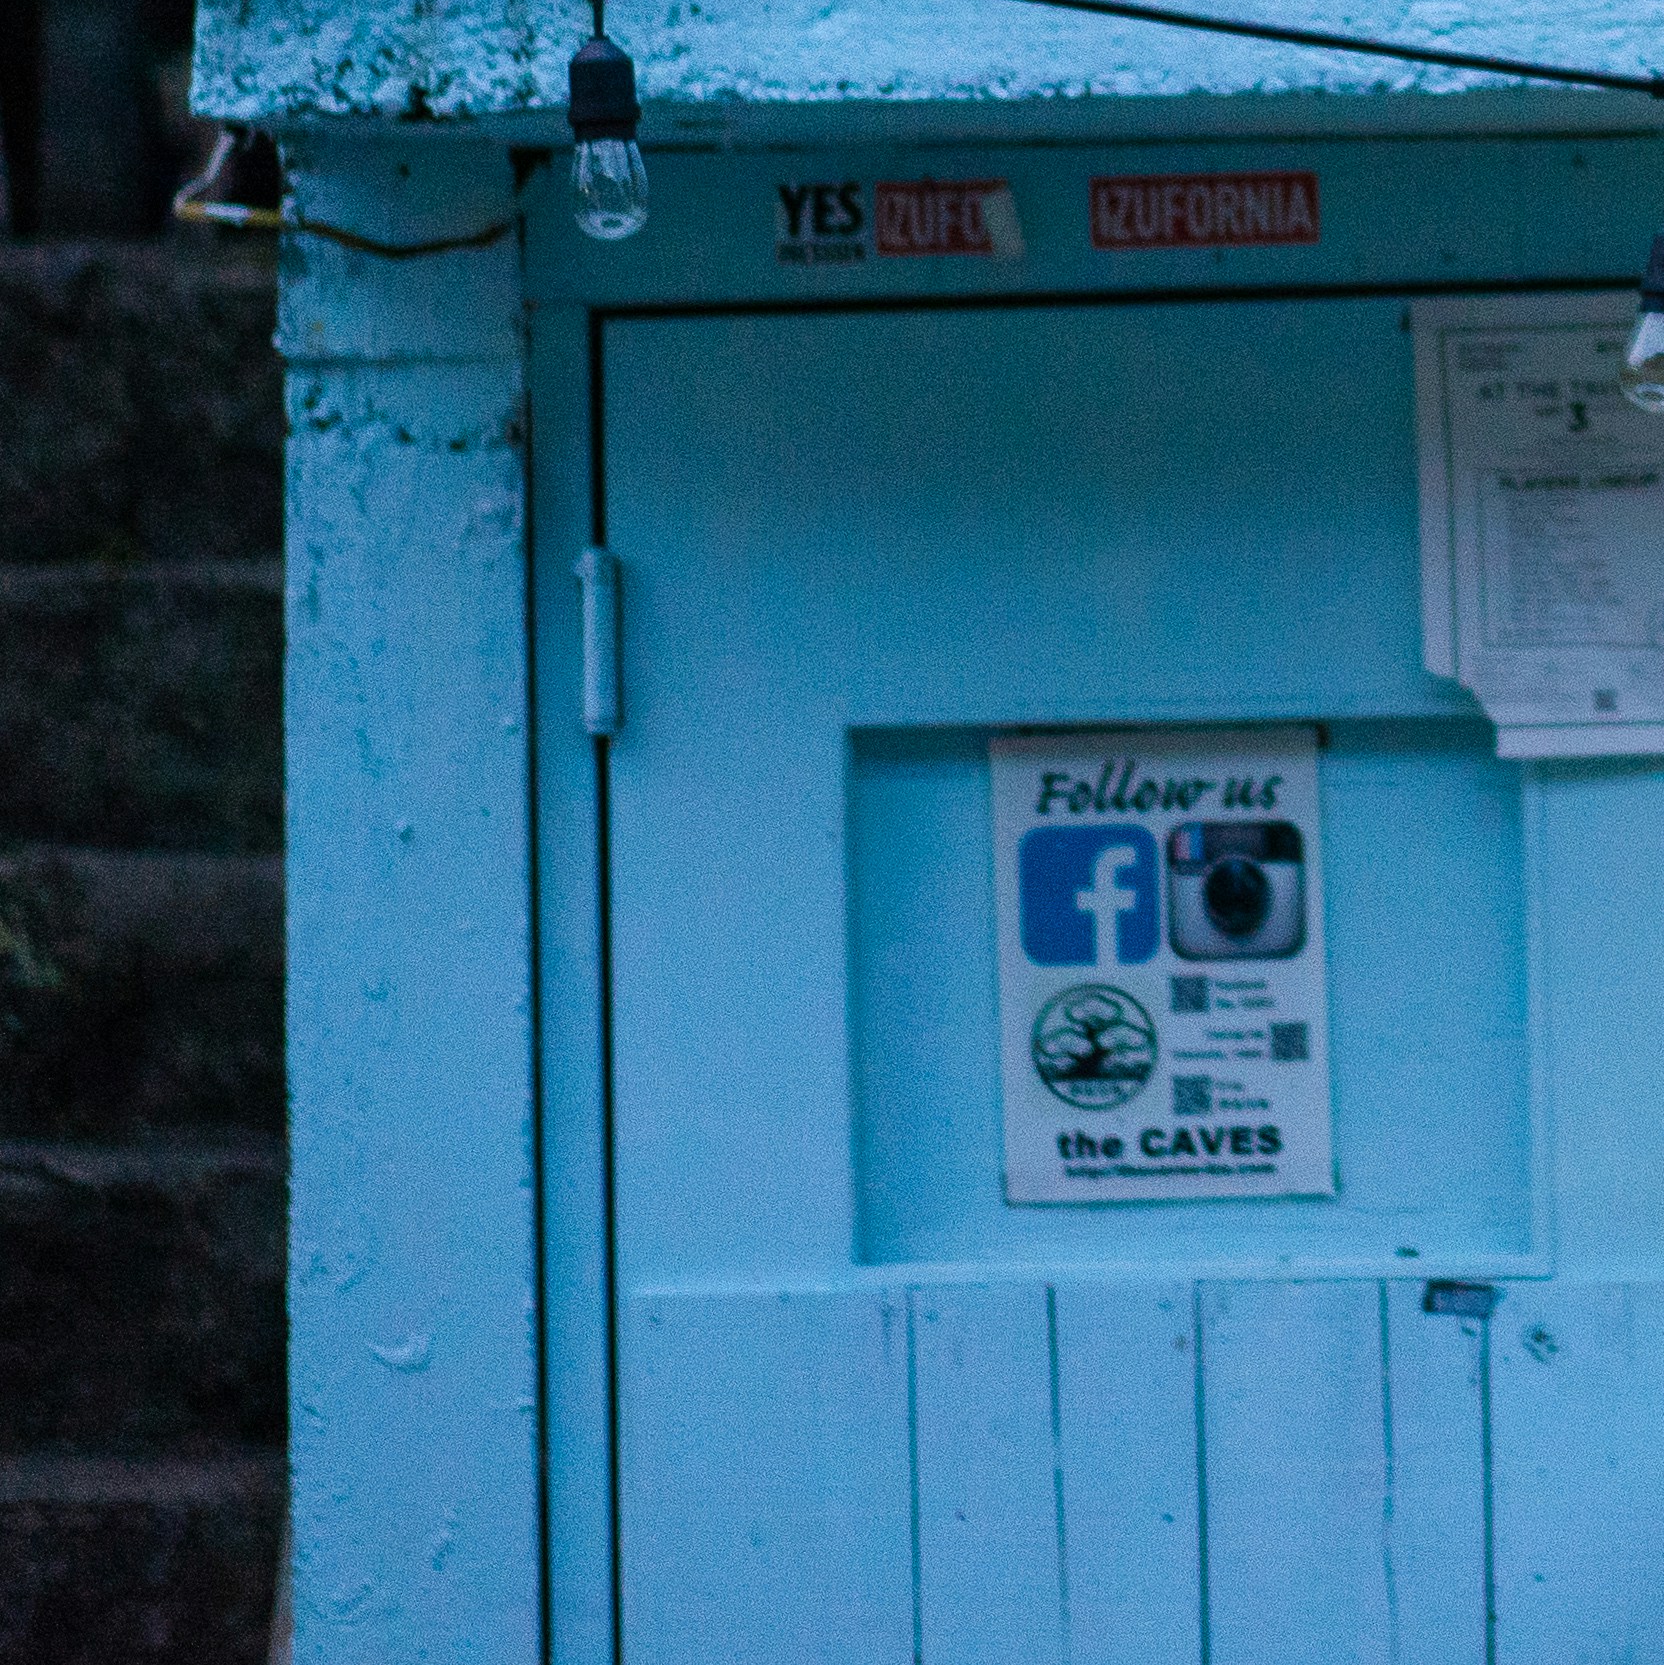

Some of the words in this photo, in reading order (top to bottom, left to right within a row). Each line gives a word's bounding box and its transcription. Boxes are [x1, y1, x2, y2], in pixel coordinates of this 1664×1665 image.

[778, 182, 863, 236] YES
[1096, 183, 1314, 239] IZUFORNIA
[1037, 757, 1217, 815] Follow
[1221, 773, 1283, 811] us
[1057, 1129, 1125, 1160] the
[1139, 1124, 1284, 1158] CAVES
